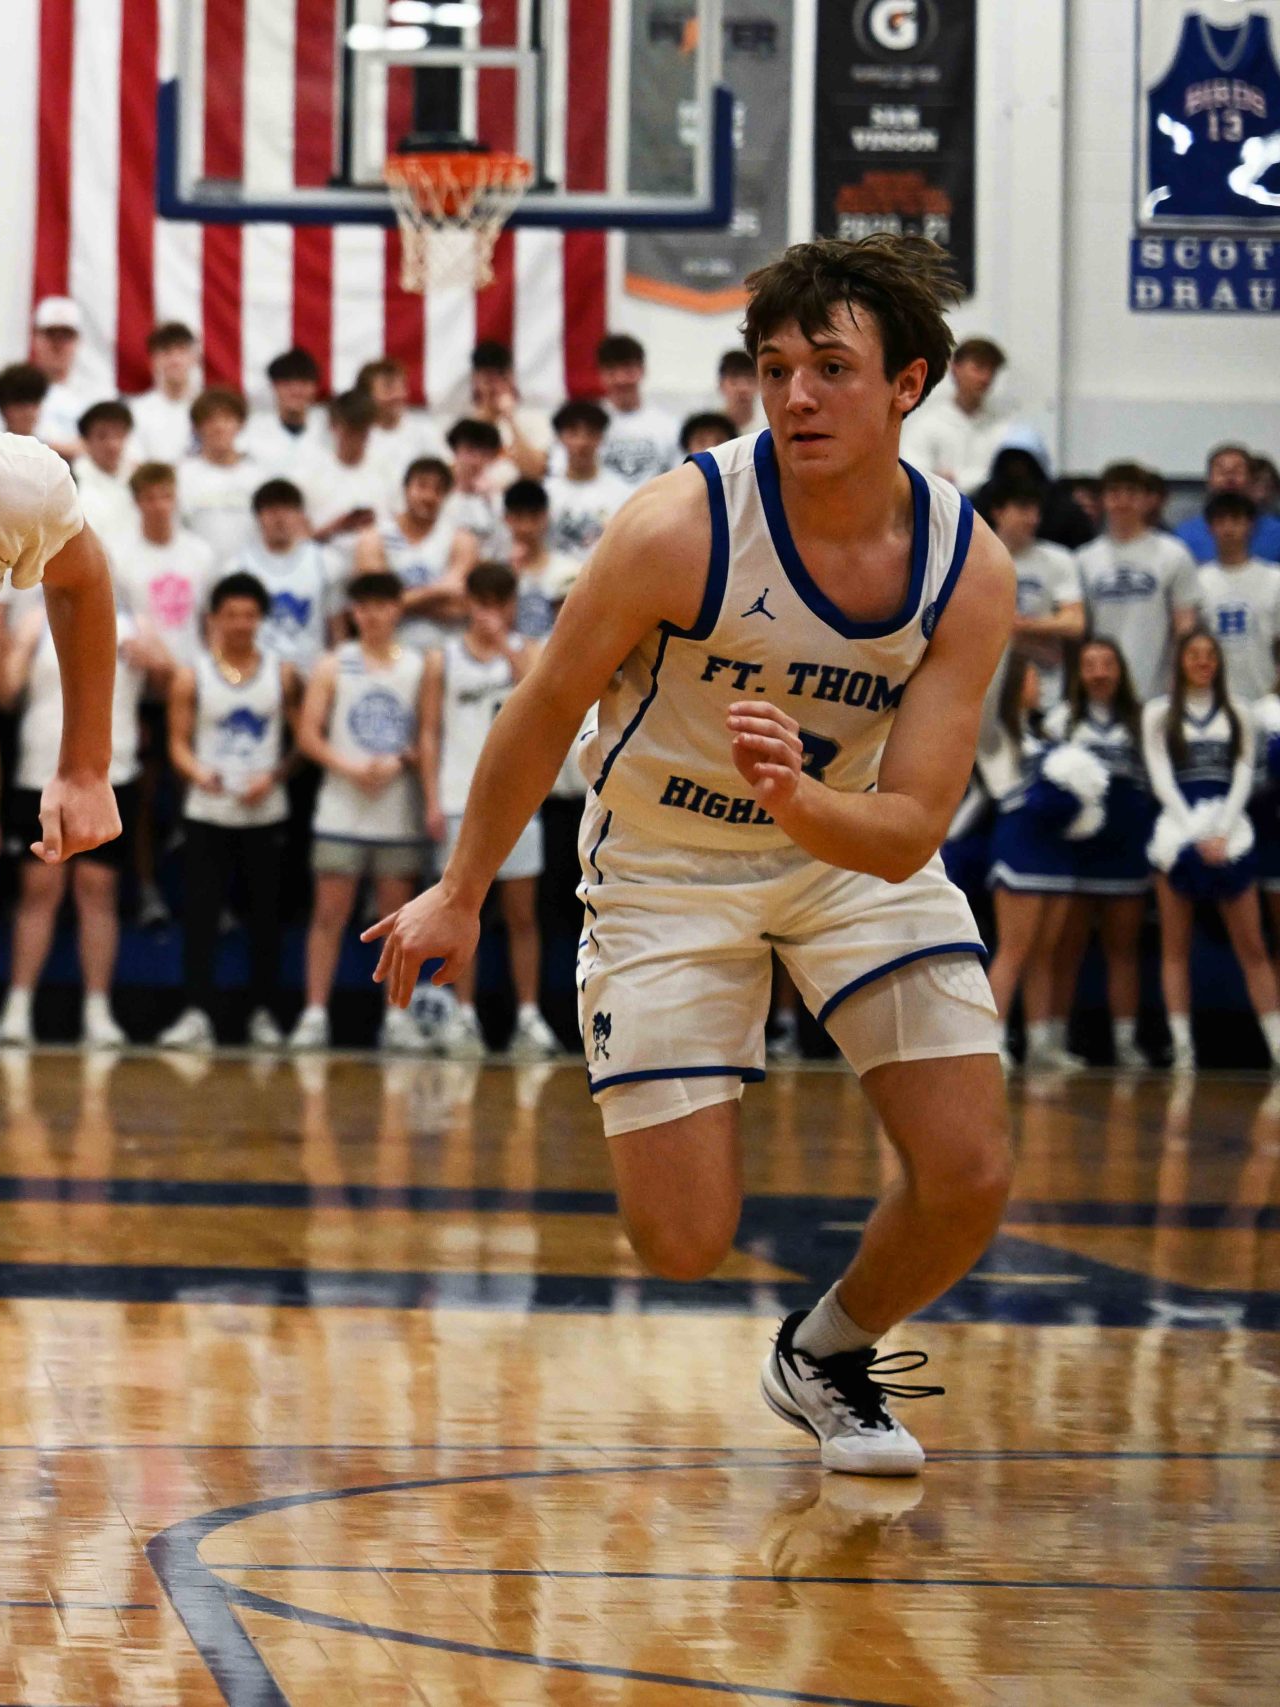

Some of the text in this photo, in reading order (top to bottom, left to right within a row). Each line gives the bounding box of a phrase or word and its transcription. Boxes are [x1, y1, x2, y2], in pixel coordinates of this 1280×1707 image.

[1140, 235, 1274, 270] SCOT
[1135, 276, 1276, 311] DRAU
[701, 655, 765, 692] FT.
